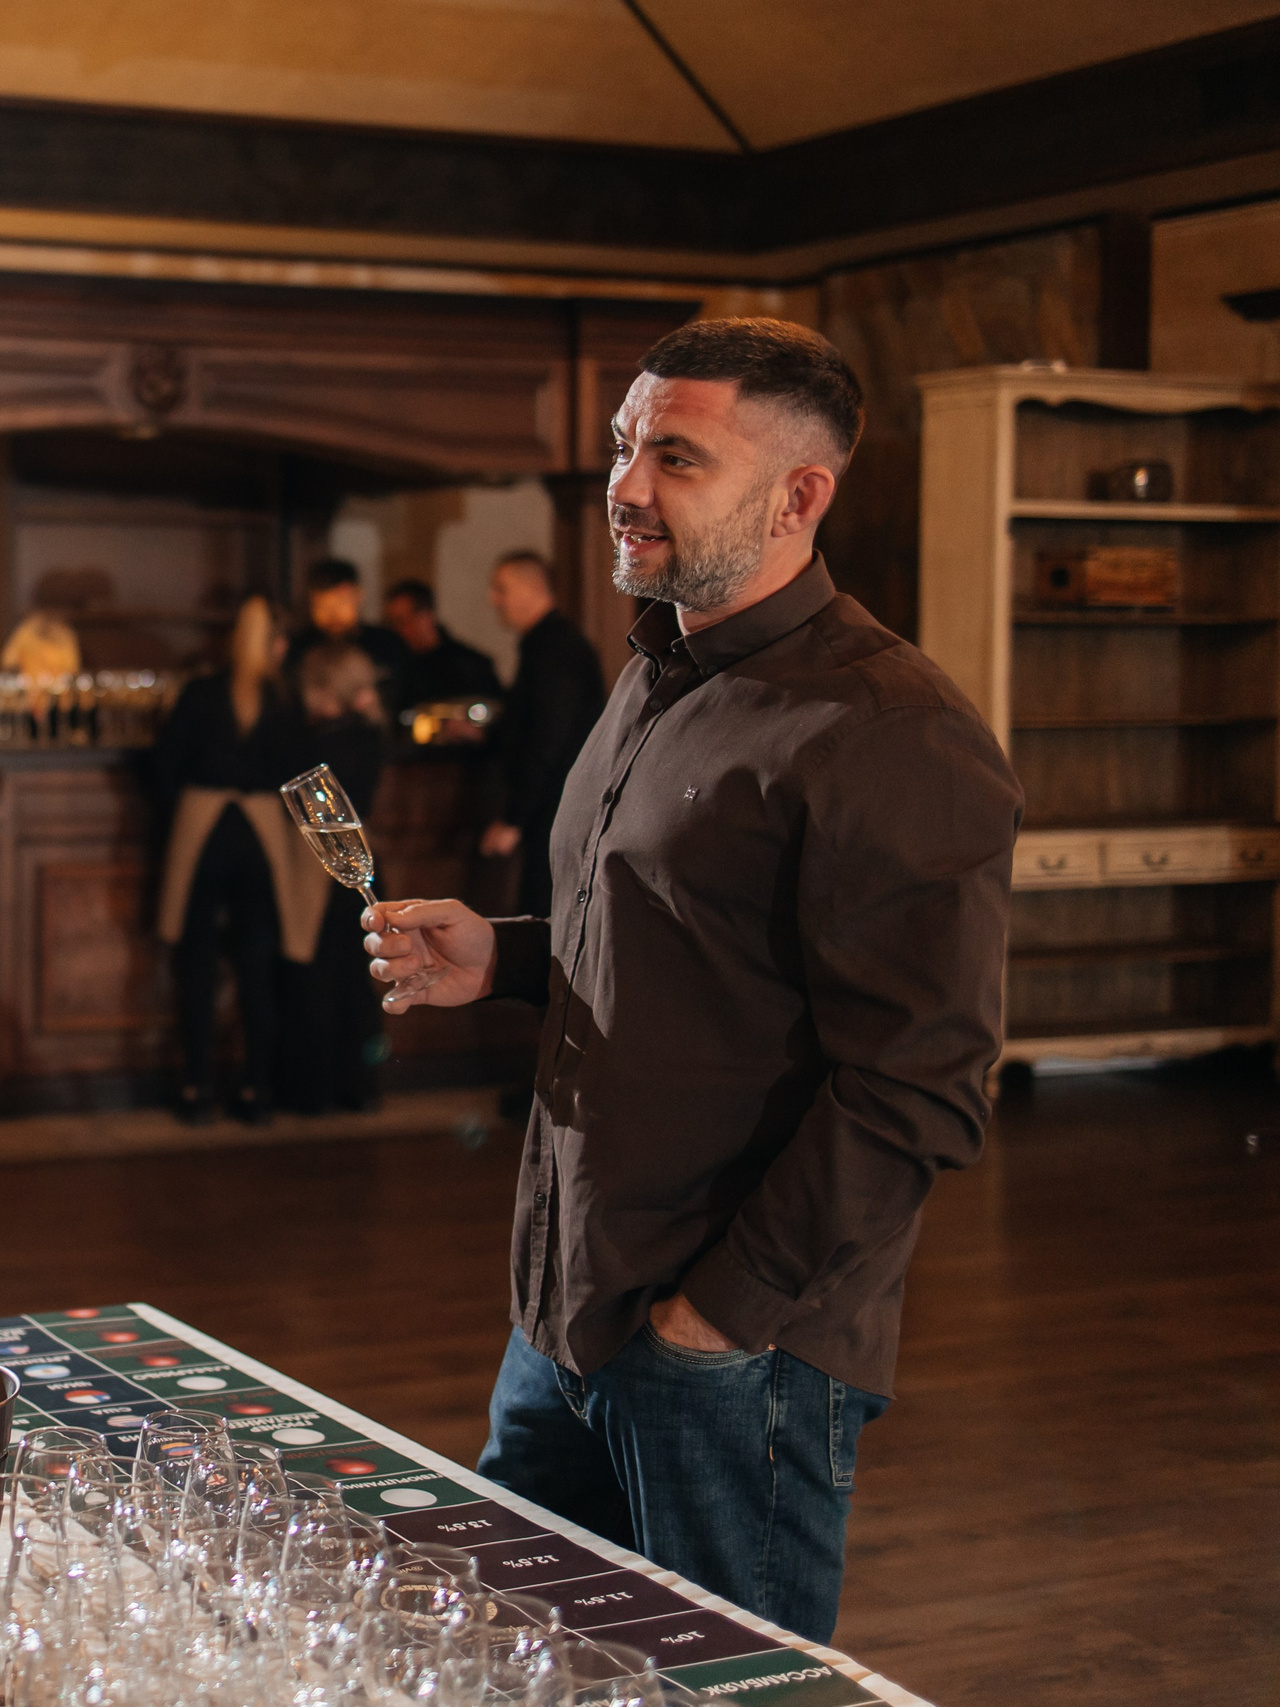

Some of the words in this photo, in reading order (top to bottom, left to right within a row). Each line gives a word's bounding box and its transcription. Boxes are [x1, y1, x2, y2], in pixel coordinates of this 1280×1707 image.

[89, 1407, 132, 1416] США
[437, 1519, 493, 1533] 13.5%
[502, 1554, 560, 1569] 12.5%
[574, 1591, 634, 1607] 11.5%
[660, 1630, 706, 1645] 10%
[700, 1666, 833, 1697] АССАМБЛЯЖ
